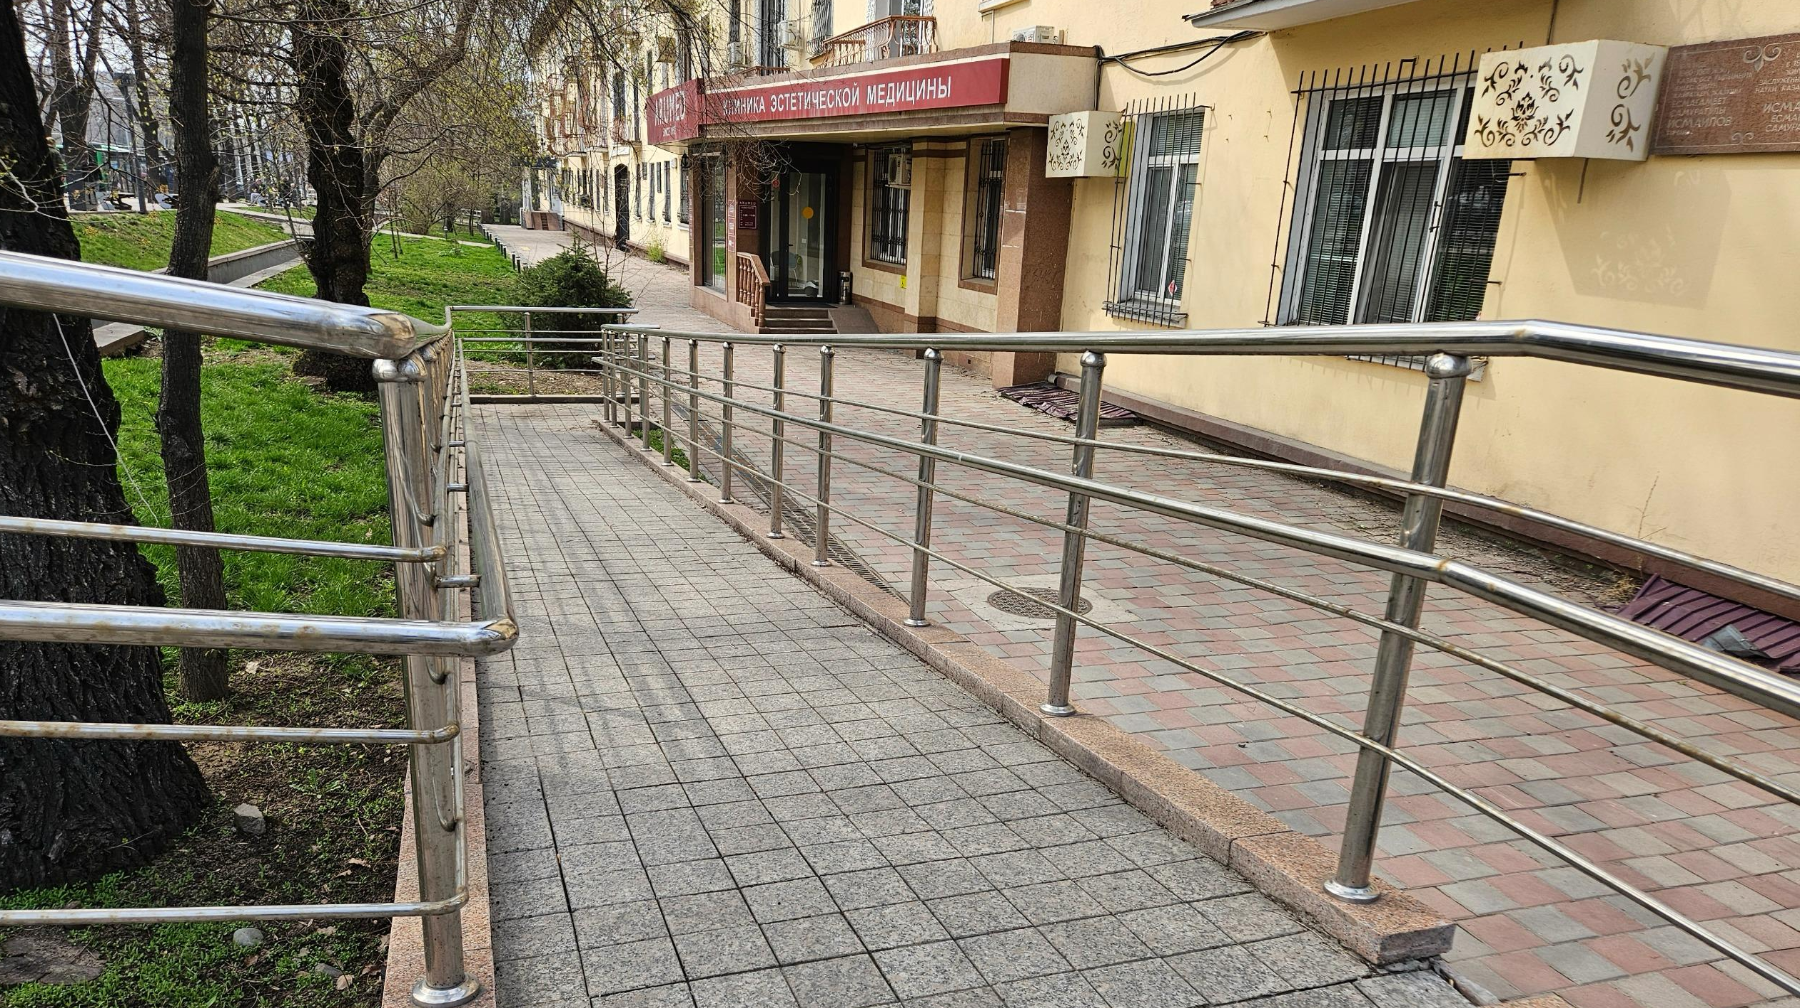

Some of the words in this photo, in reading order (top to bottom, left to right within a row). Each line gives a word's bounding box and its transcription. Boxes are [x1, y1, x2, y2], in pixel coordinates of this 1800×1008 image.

[770, 82, 860, 113] ЭСТЕТИЧЕСКОЙ
[866, 75, 952, 107] МЕДИЦИНЫ
[1667, 116, 1732, 128] ИСМАИЛОВ
